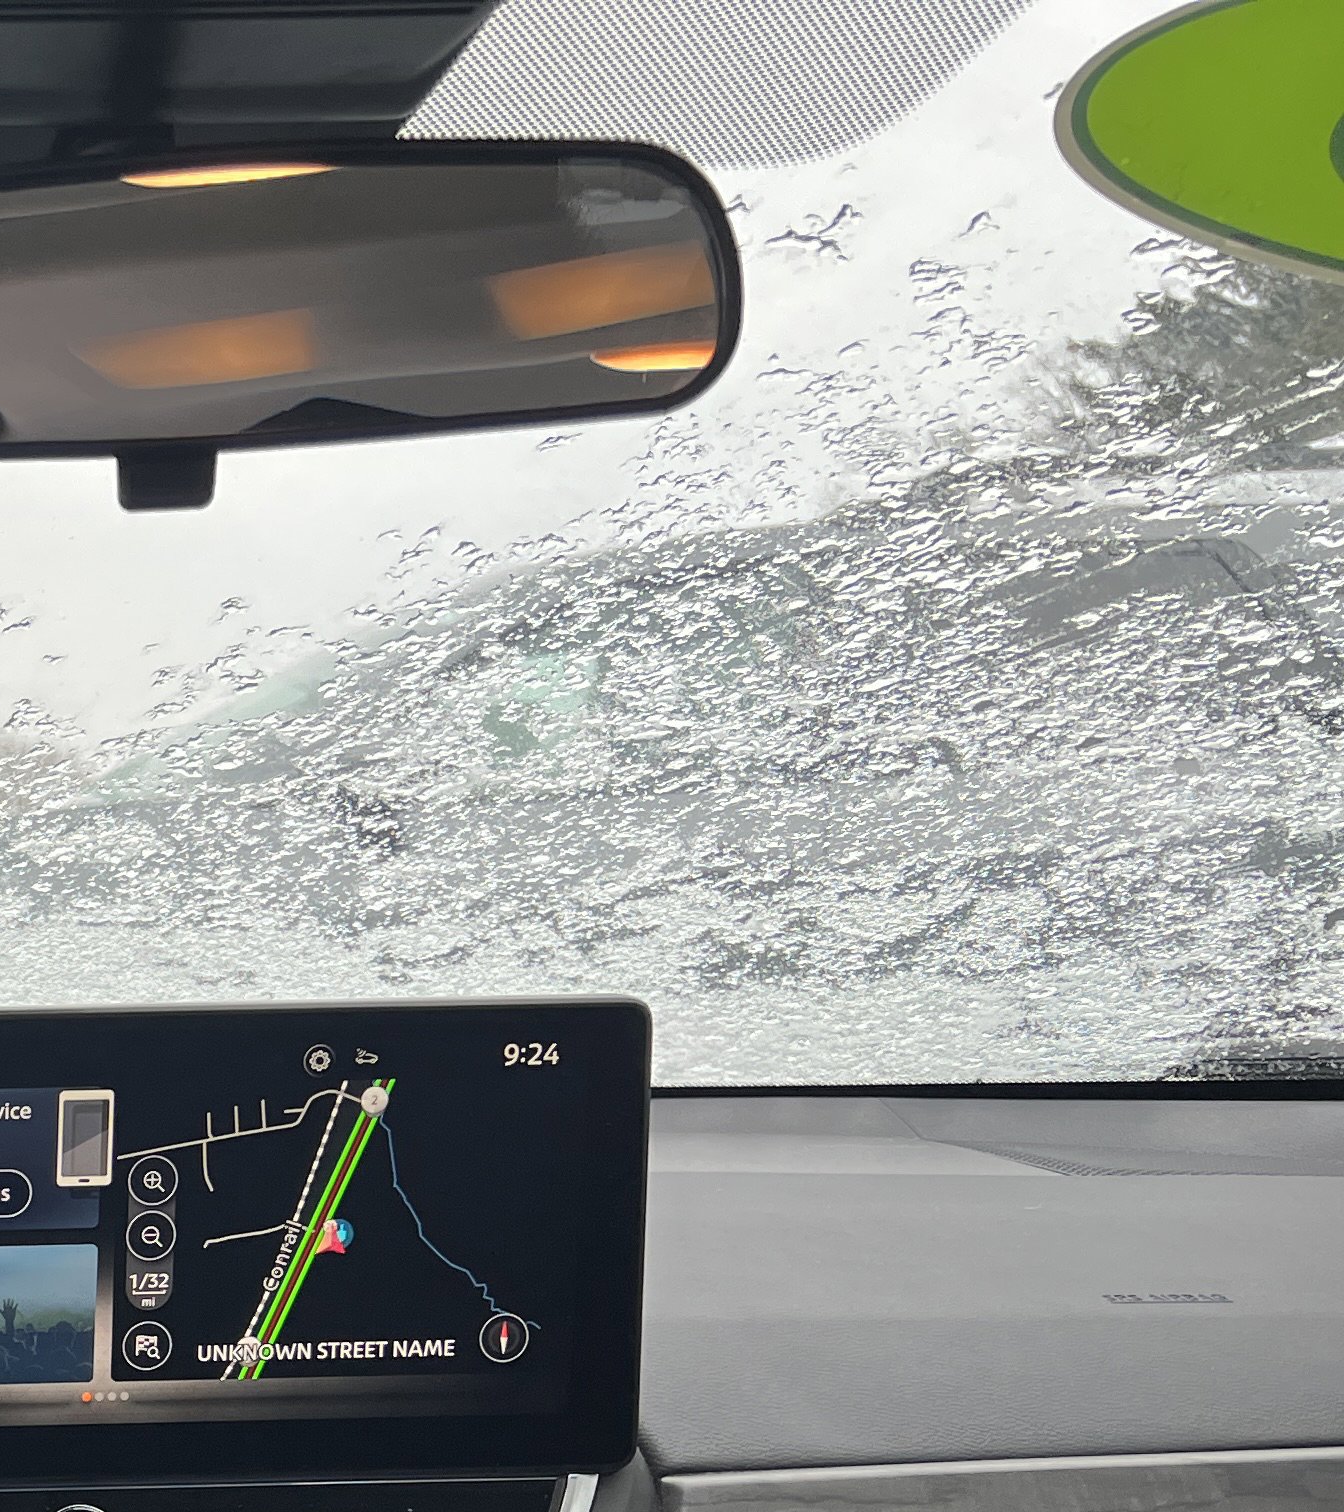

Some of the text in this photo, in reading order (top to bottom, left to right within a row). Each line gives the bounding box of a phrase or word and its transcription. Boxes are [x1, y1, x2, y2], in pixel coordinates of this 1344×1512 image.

[503, 1042, 560, 1066] 9:24
[262, 1219, 303, 1292] Conrail
[129, 1272, 170, 1291] 1/32
[197, 1339, 456, 1363] UNKNOWN STREET NAME
